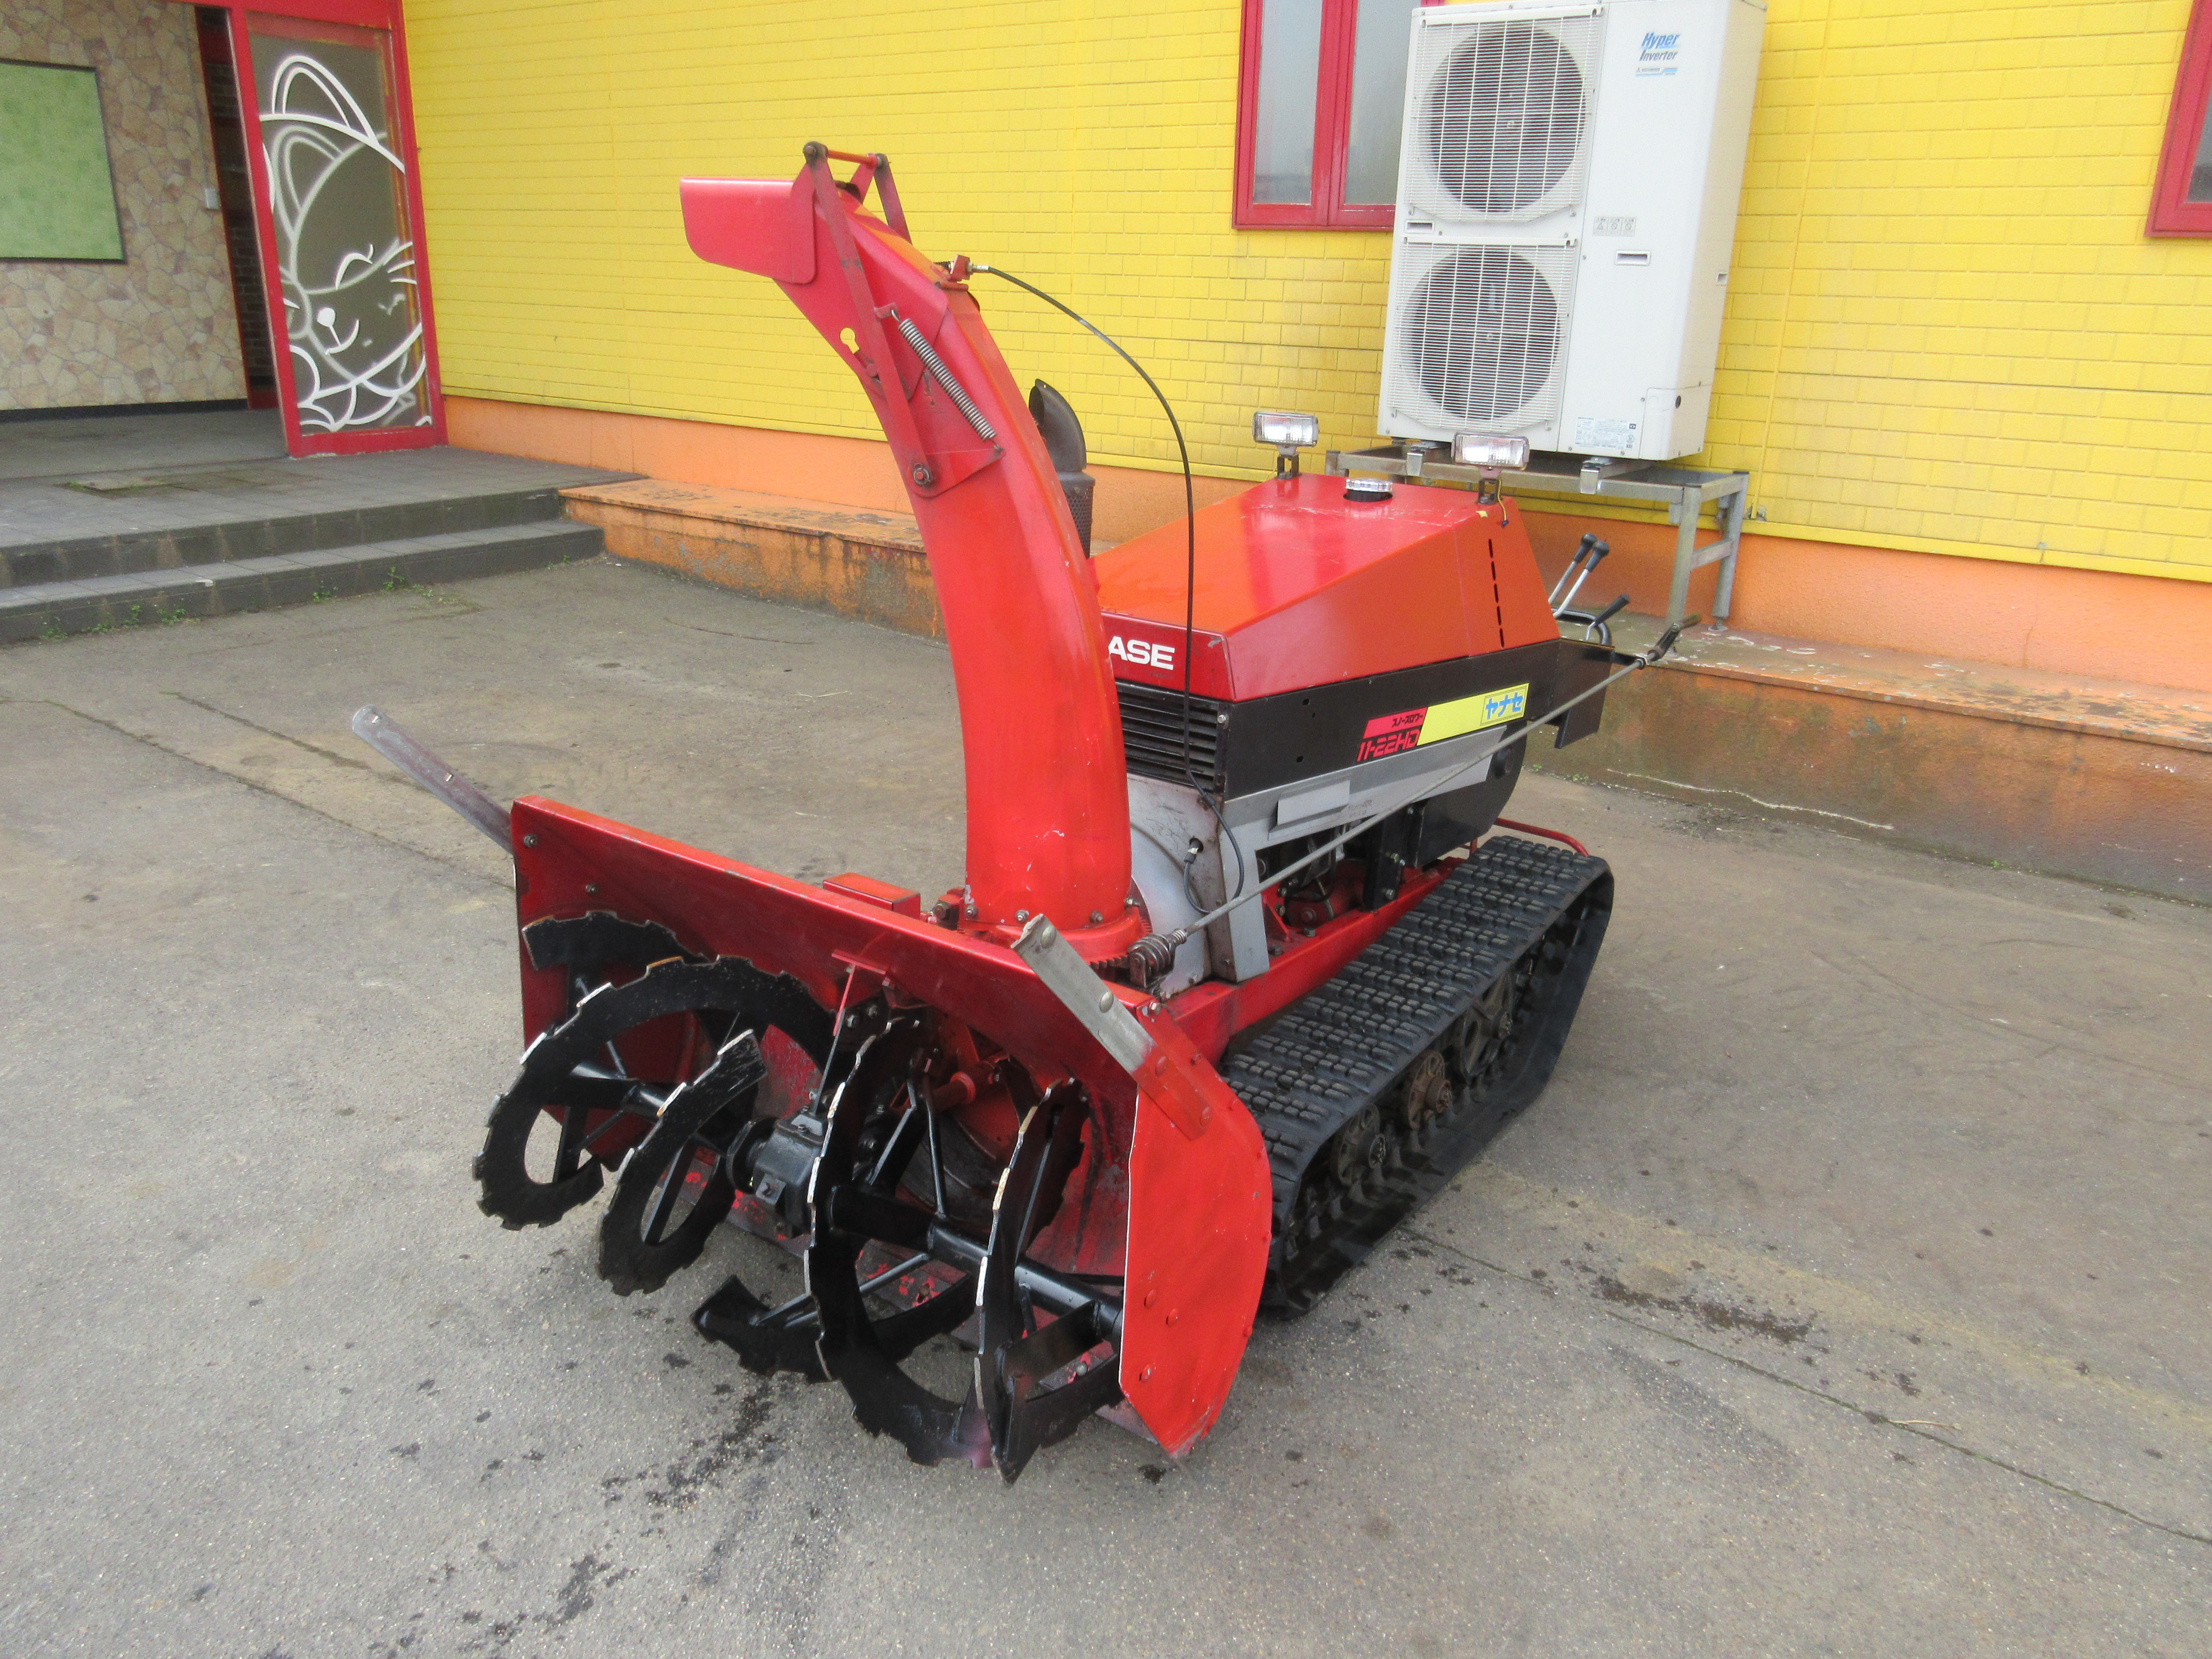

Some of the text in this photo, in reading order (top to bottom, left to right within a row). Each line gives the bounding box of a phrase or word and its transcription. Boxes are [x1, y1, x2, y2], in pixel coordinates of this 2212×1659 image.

[1641, 32, 1680, 49] Hyper
[1639, 49, 1678, 61] Inverter
[1486, 692, 1523, 719] ヤナセ
